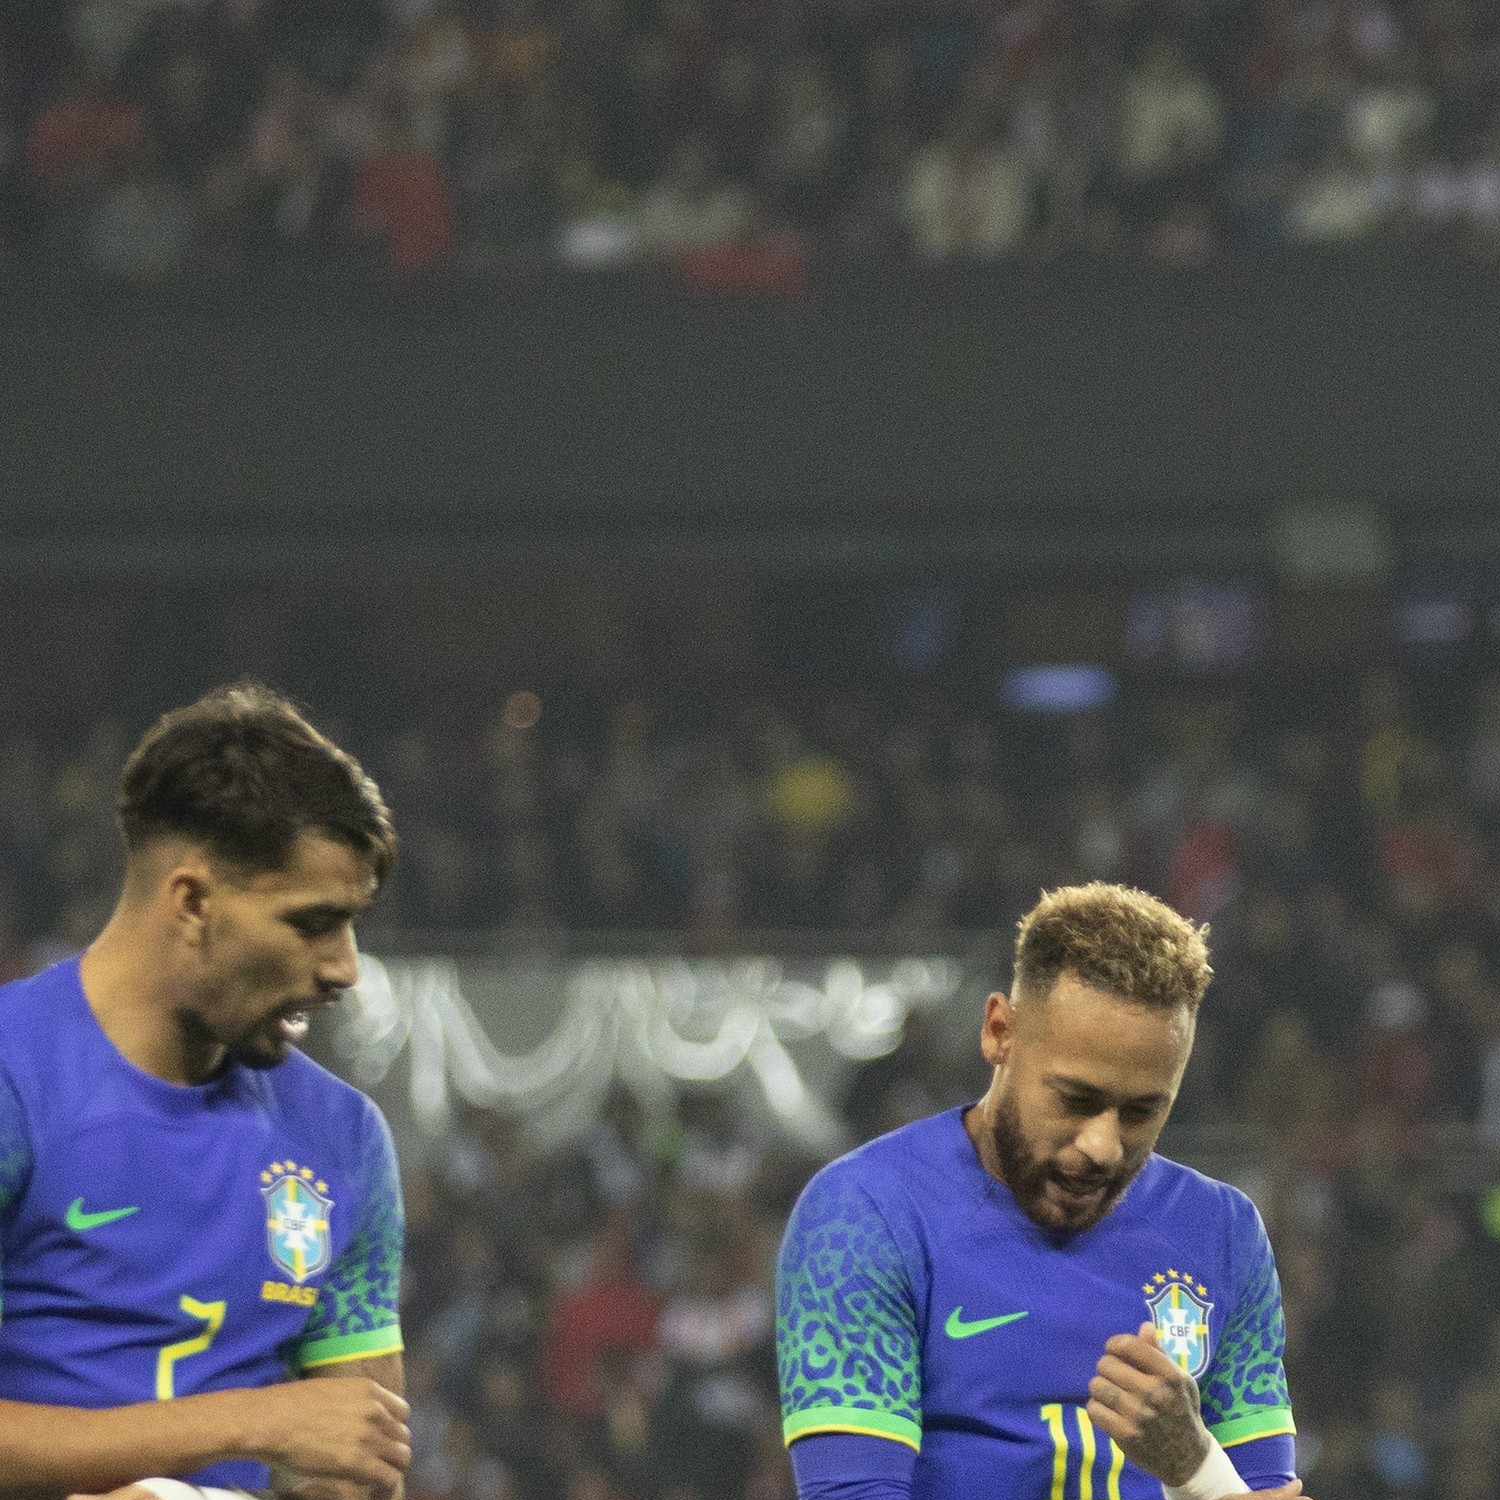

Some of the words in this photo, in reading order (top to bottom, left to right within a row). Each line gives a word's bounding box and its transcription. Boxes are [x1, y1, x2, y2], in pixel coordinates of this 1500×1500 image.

[262, 1281, 319, 1307] BRAS
[1170, 1325, 1190, 1337] CBF
[157, 1295, 226, 1400] 7
